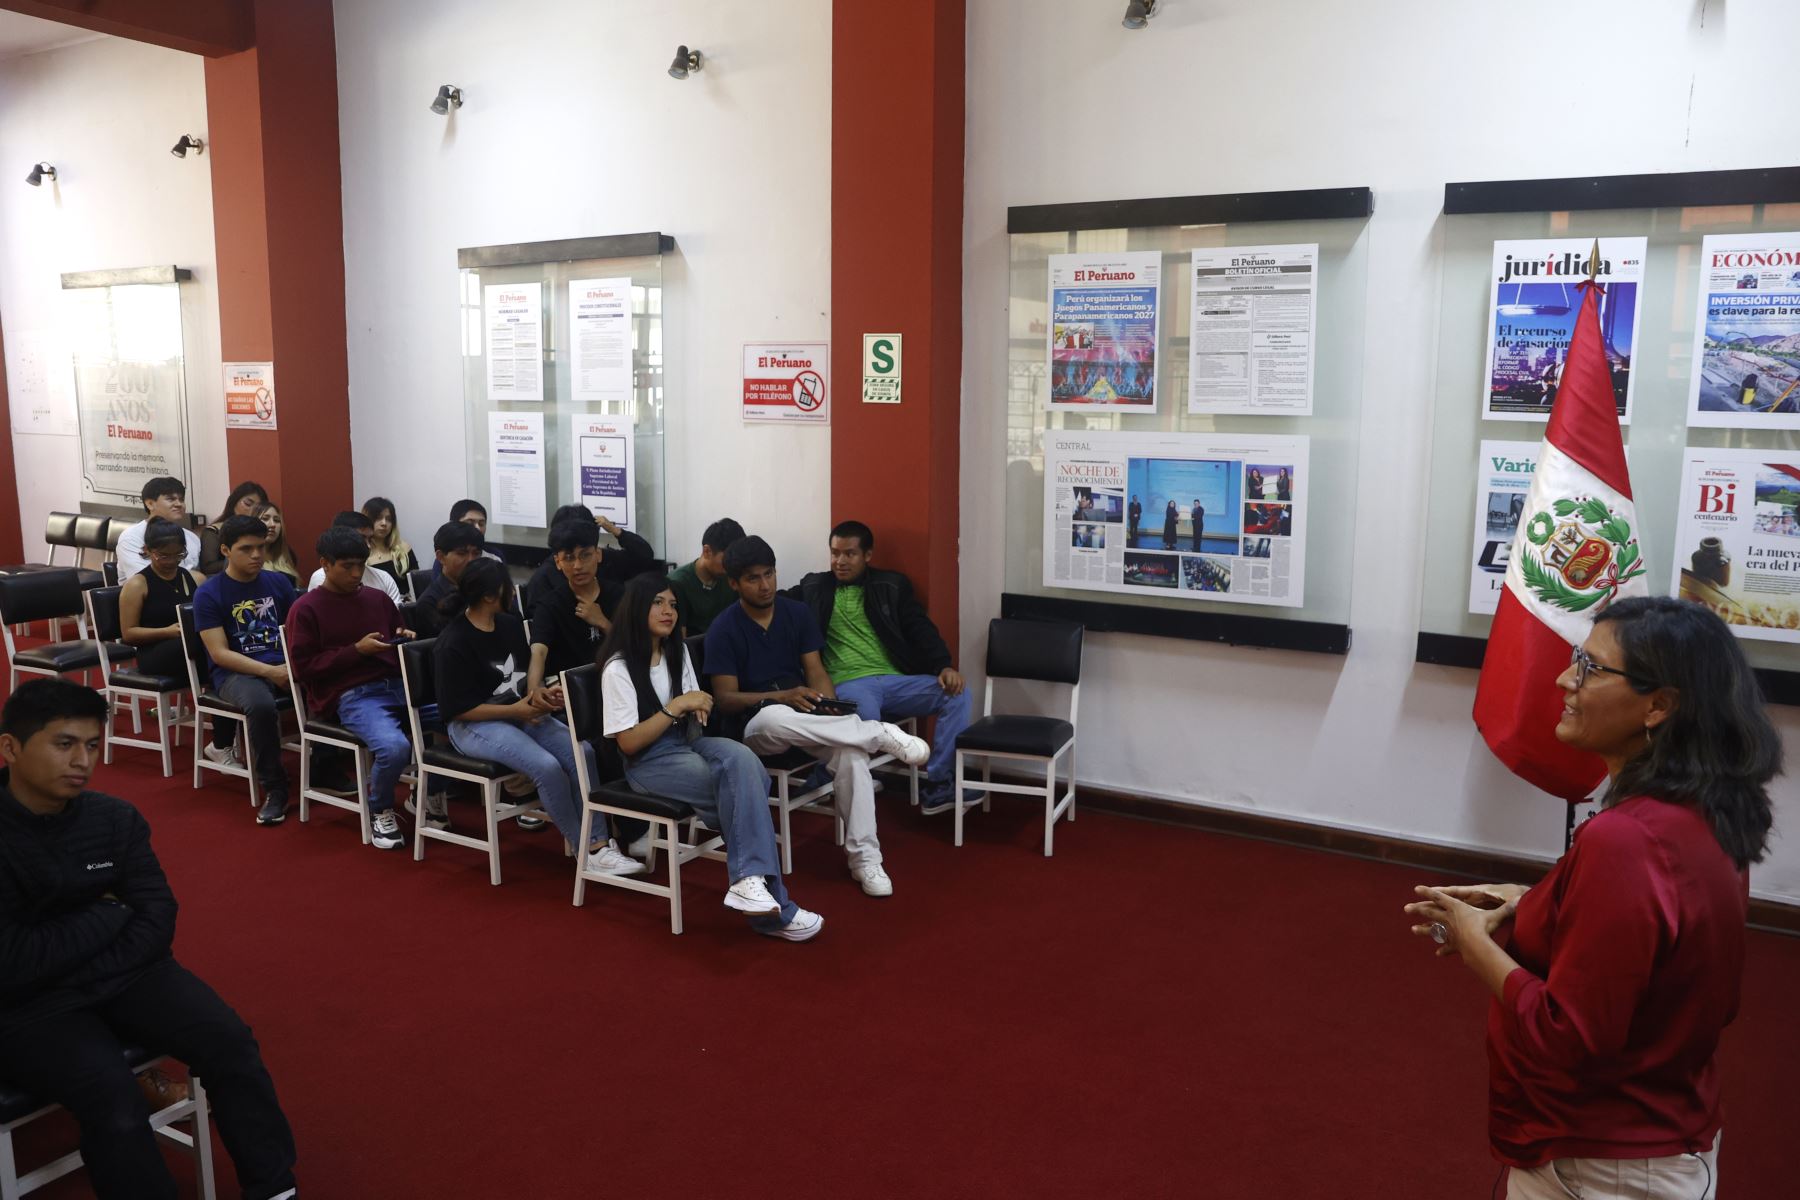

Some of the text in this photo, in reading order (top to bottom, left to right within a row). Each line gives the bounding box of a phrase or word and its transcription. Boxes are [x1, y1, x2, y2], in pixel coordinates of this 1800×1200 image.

[1232, 258, 1276, 266] El Peruano
[1712, 249, 1800, 267] ECONÓM
[1074, 271, 1085, 281] El
[1088, 271, 1135, 281] Peruano
[1066, 294, 1143, 305] Perú organizará los
[1711, 295, 1800, 306] INVERSIÓN PRIV
[1056, 304, 1083, 312] Juegos
[1709, 307, 1720, 316] es
[1722, 307, 1750, 316] clave
[1752, 308, 1776, 317] para
[1778, 306, 1788, 315] la
[1054, 312, 1133, 320] Parapanamericanos
[1499, 325, 1566, 336] El recurso
[1498, 337, 1513, 348] de
[758, 357, 812, 368] El Peruano
[872, 340, 894, 374] S
[233, 377, 264, 386] El Peruano
[760, 392, 792, 400] TELÉFONO
[107, 424, 153, 440] El Peruano
[509, 423, 528, 431] Peruano
[1055, 442, 1091, 450] CENTRAL
[95, 450, 130, 461] Preservando
[131, 452, 137, 460] la
[96, 464, 122, 473] narrando
[123, 465, 145, 474] nuestra
[1061, 465, 1120, 478] NOCHE DE
[1057, 476, 1123, 486] RECONOCIMIENTO
[1696, 483, 1736, 514] Bi
[1694, 513, 1738, 522] centenario
[1748, 546, 1763, 556] La
[1746, 561, 1766, 569] era
[1770, 560, 1788, 571] del
